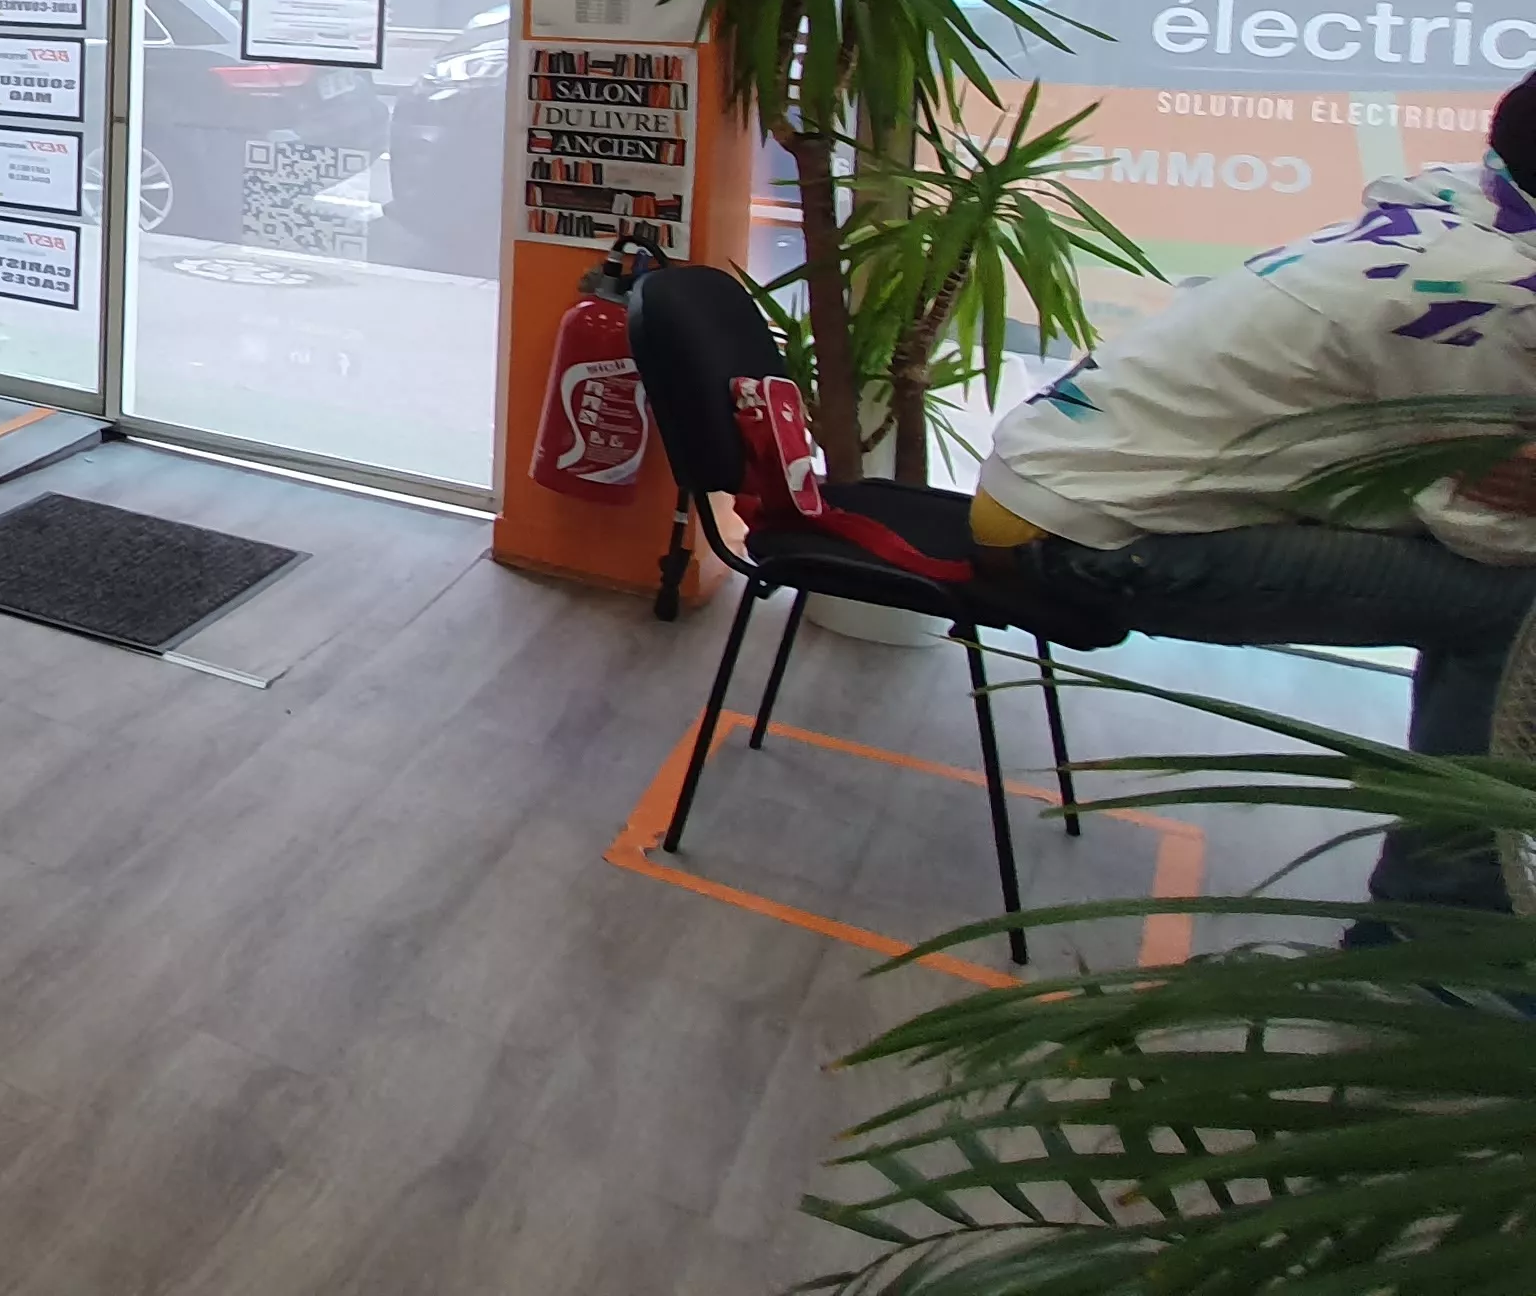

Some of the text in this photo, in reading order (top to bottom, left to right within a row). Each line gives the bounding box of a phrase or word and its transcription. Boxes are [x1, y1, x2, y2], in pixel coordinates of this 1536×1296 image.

[555, 80, 646, 103] SALON
[1156, 91, 1294, 122] SOLUTION
[545, 107, 670, 133] DU LIVRE
[554, 134, 659, 159] ANCIEN
